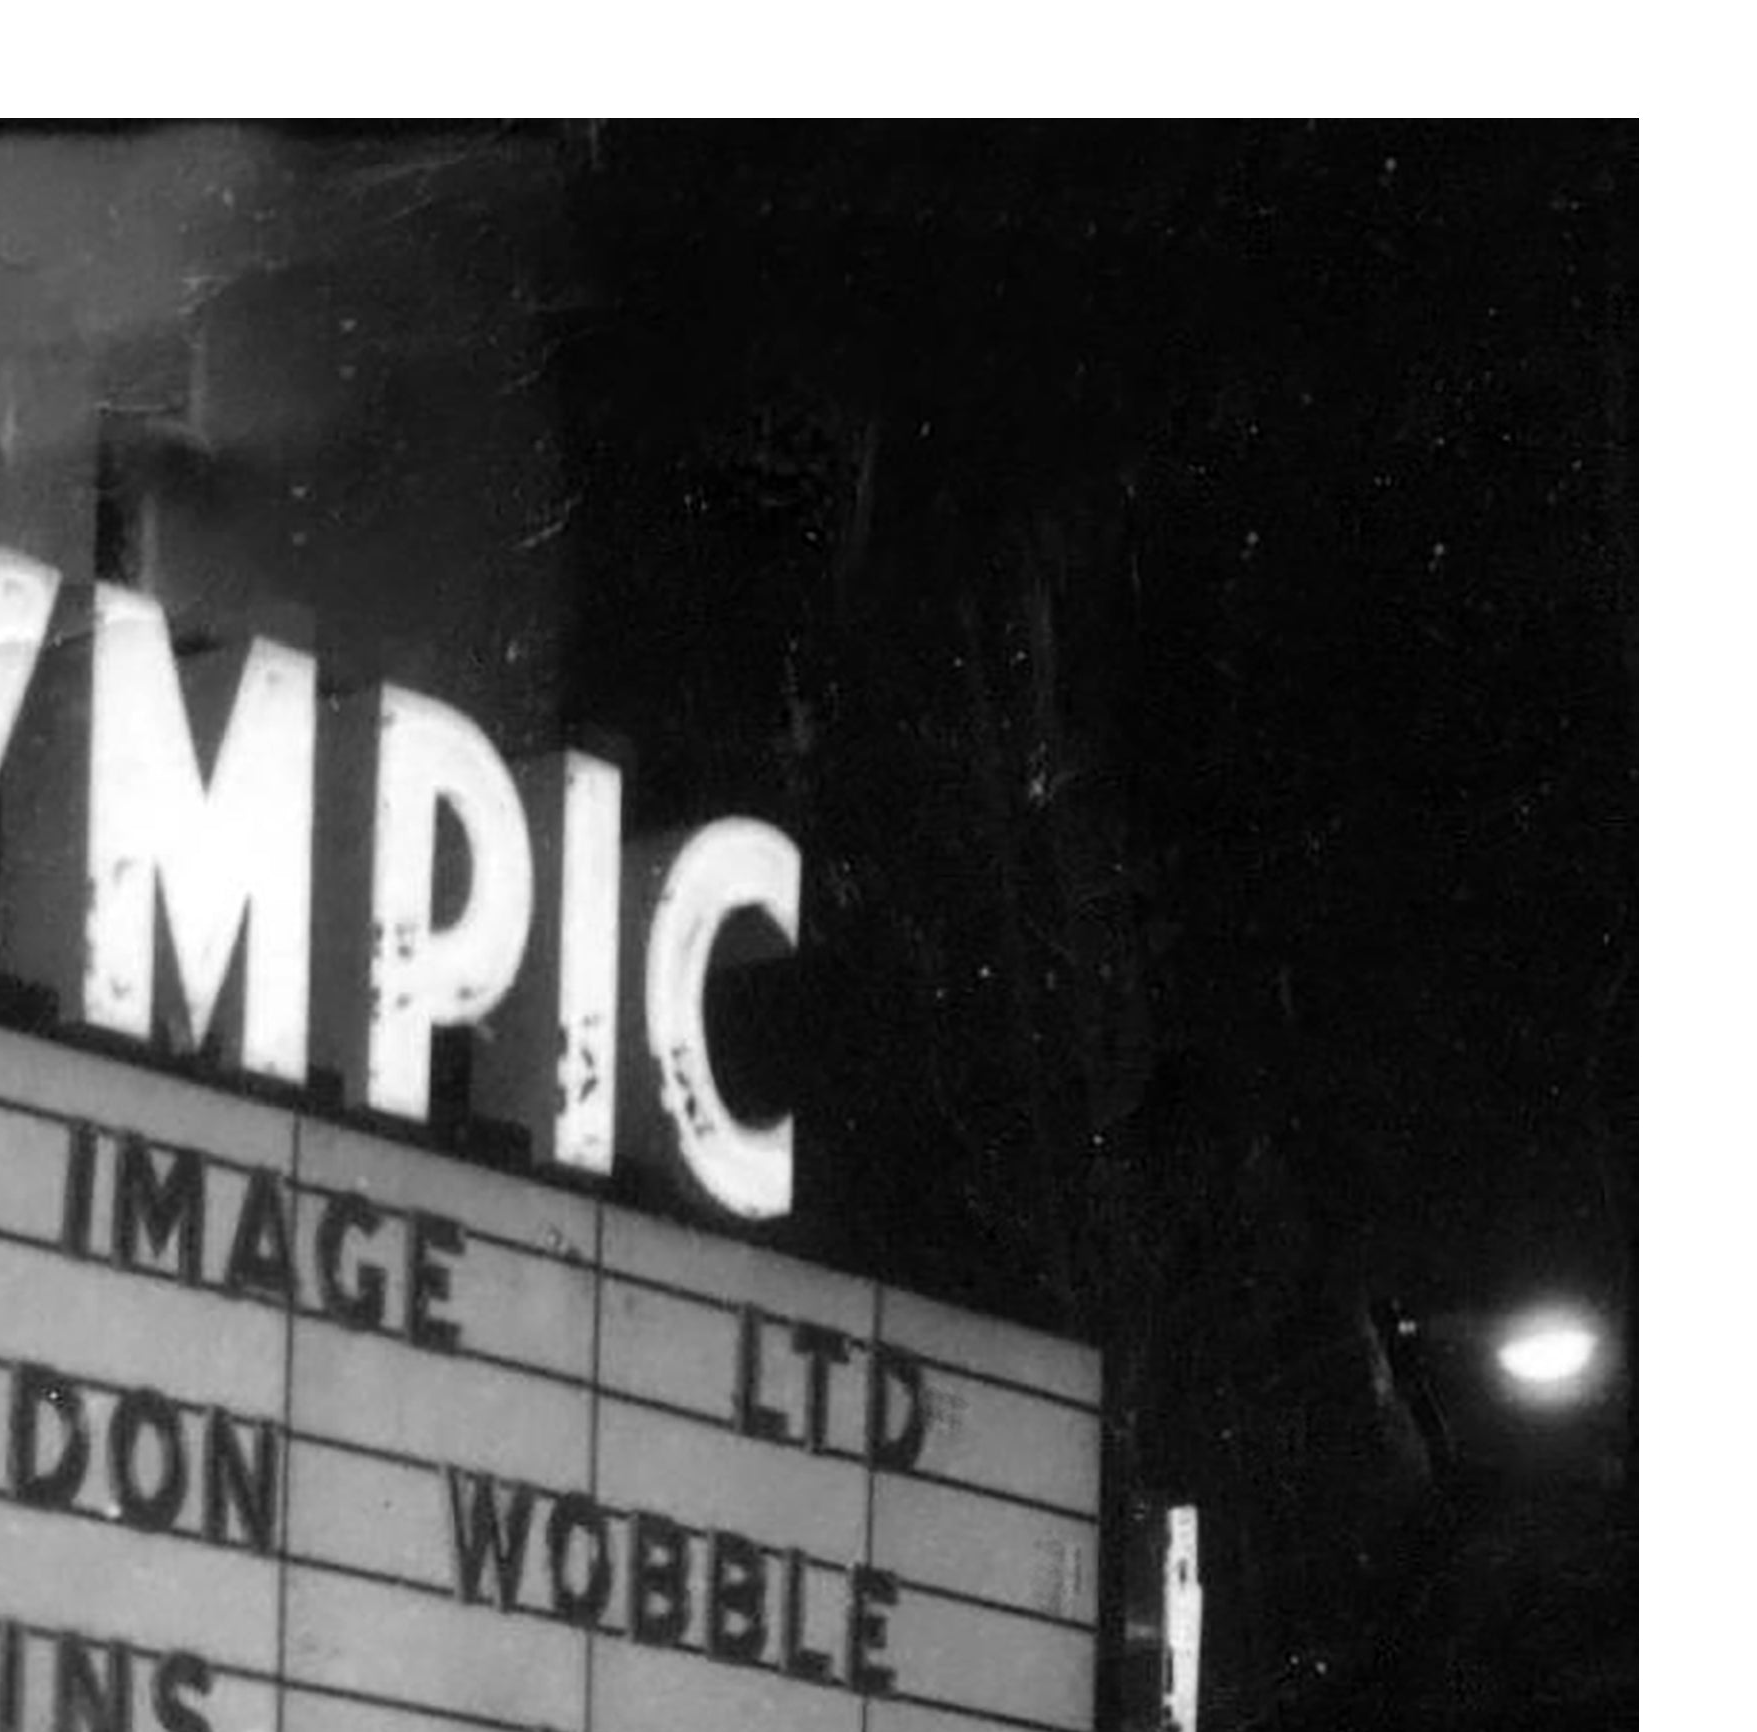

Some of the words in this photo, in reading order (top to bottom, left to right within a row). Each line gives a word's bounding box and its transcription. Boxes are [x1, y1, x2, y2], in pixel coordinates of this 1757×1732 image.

[64, 1119, 465, 1353] IMAGE
[735, 1303, 924, 1472] LTD
[446, 1466, 898, 1695] WOBBLE
